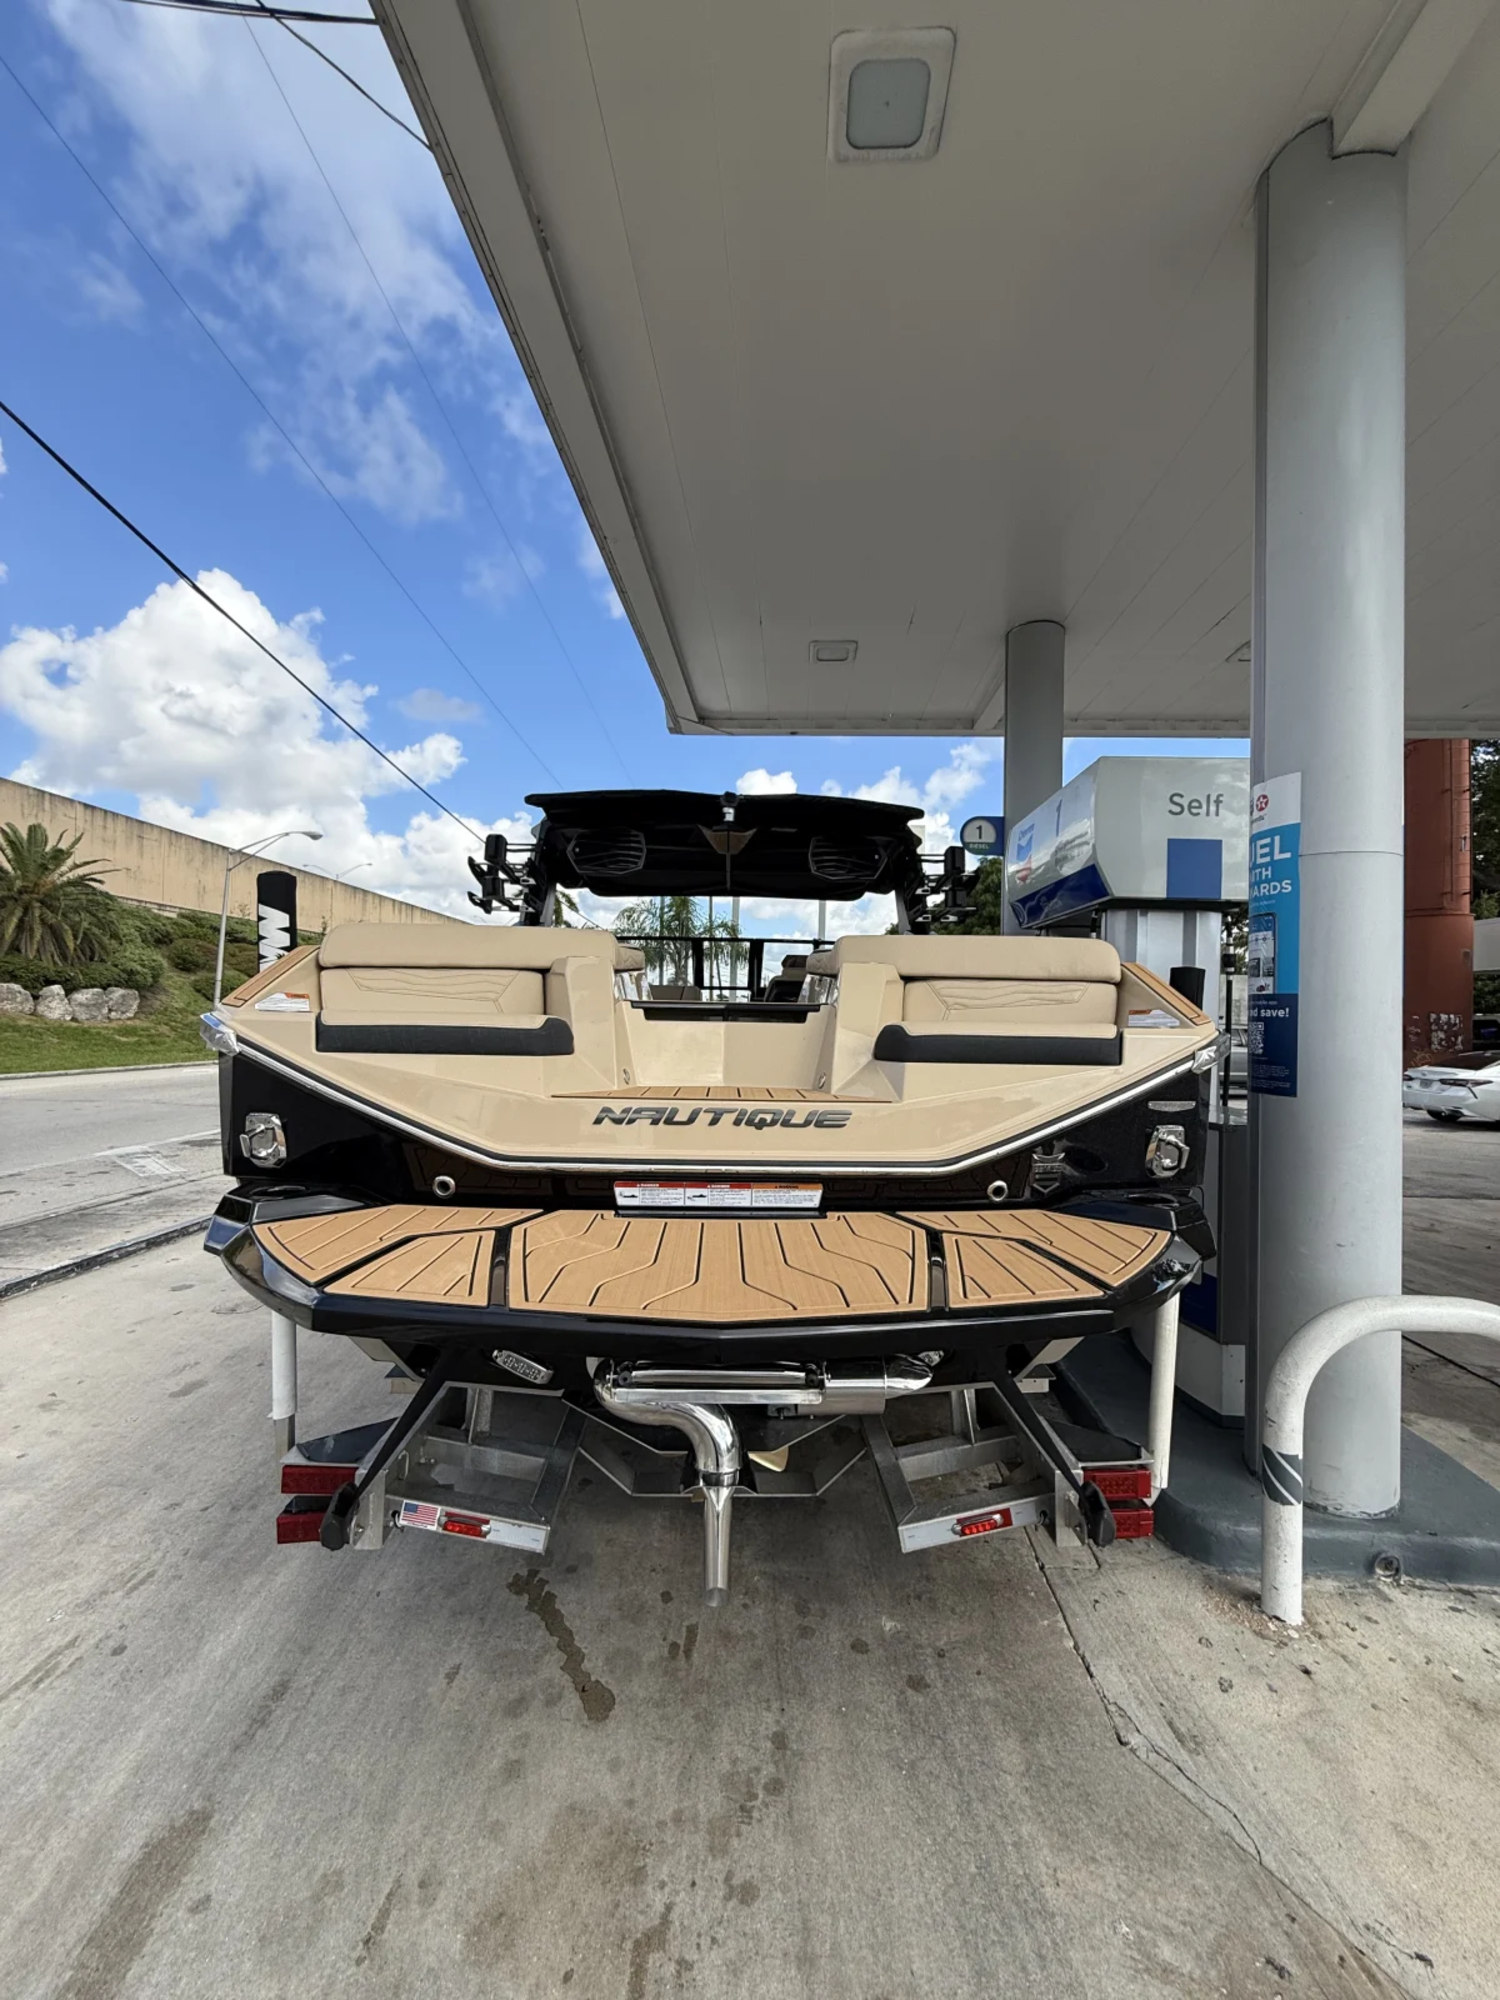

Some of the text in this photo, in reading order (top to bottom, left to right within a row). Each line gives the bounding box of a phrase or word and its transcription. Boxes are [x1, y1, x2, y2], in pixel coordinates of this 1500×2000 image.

[1168, 792, 1224, 817] Self
[1055, 799, 1063, 837] 1
[976, 824, 983, 840] 1
[969, 842, 990, 850] DIESEL
[1250, 835, 1292, 866] UEL
[1251, 866, 1272, 882] ITH
[1250, 880, 1292, 898] ARDS
[1260, 1007, 1290, 1018] save!
[593, 1106, 852, 1130] NAUTIQUE
